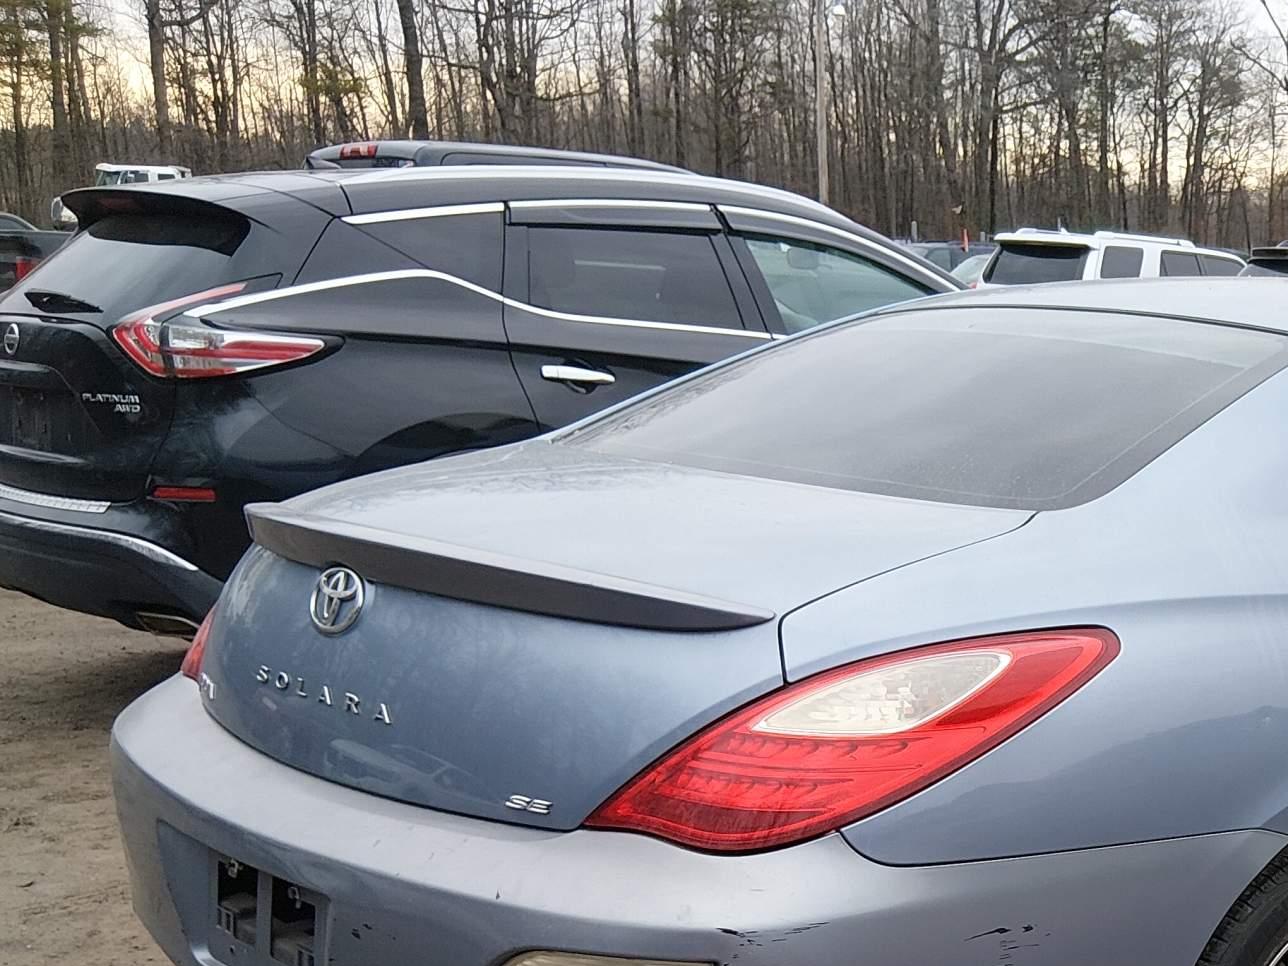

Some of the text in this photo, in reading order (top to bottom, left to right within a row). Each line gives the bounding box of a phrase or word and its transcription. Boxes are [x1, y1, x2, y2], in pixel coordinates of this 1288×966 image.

[82, 393, 139, 403] PLATINUM
[114, 404, 141, 413] AWD
[256, 664, 392, 725] SOLARA
[505, 795, 552, 814] SE
